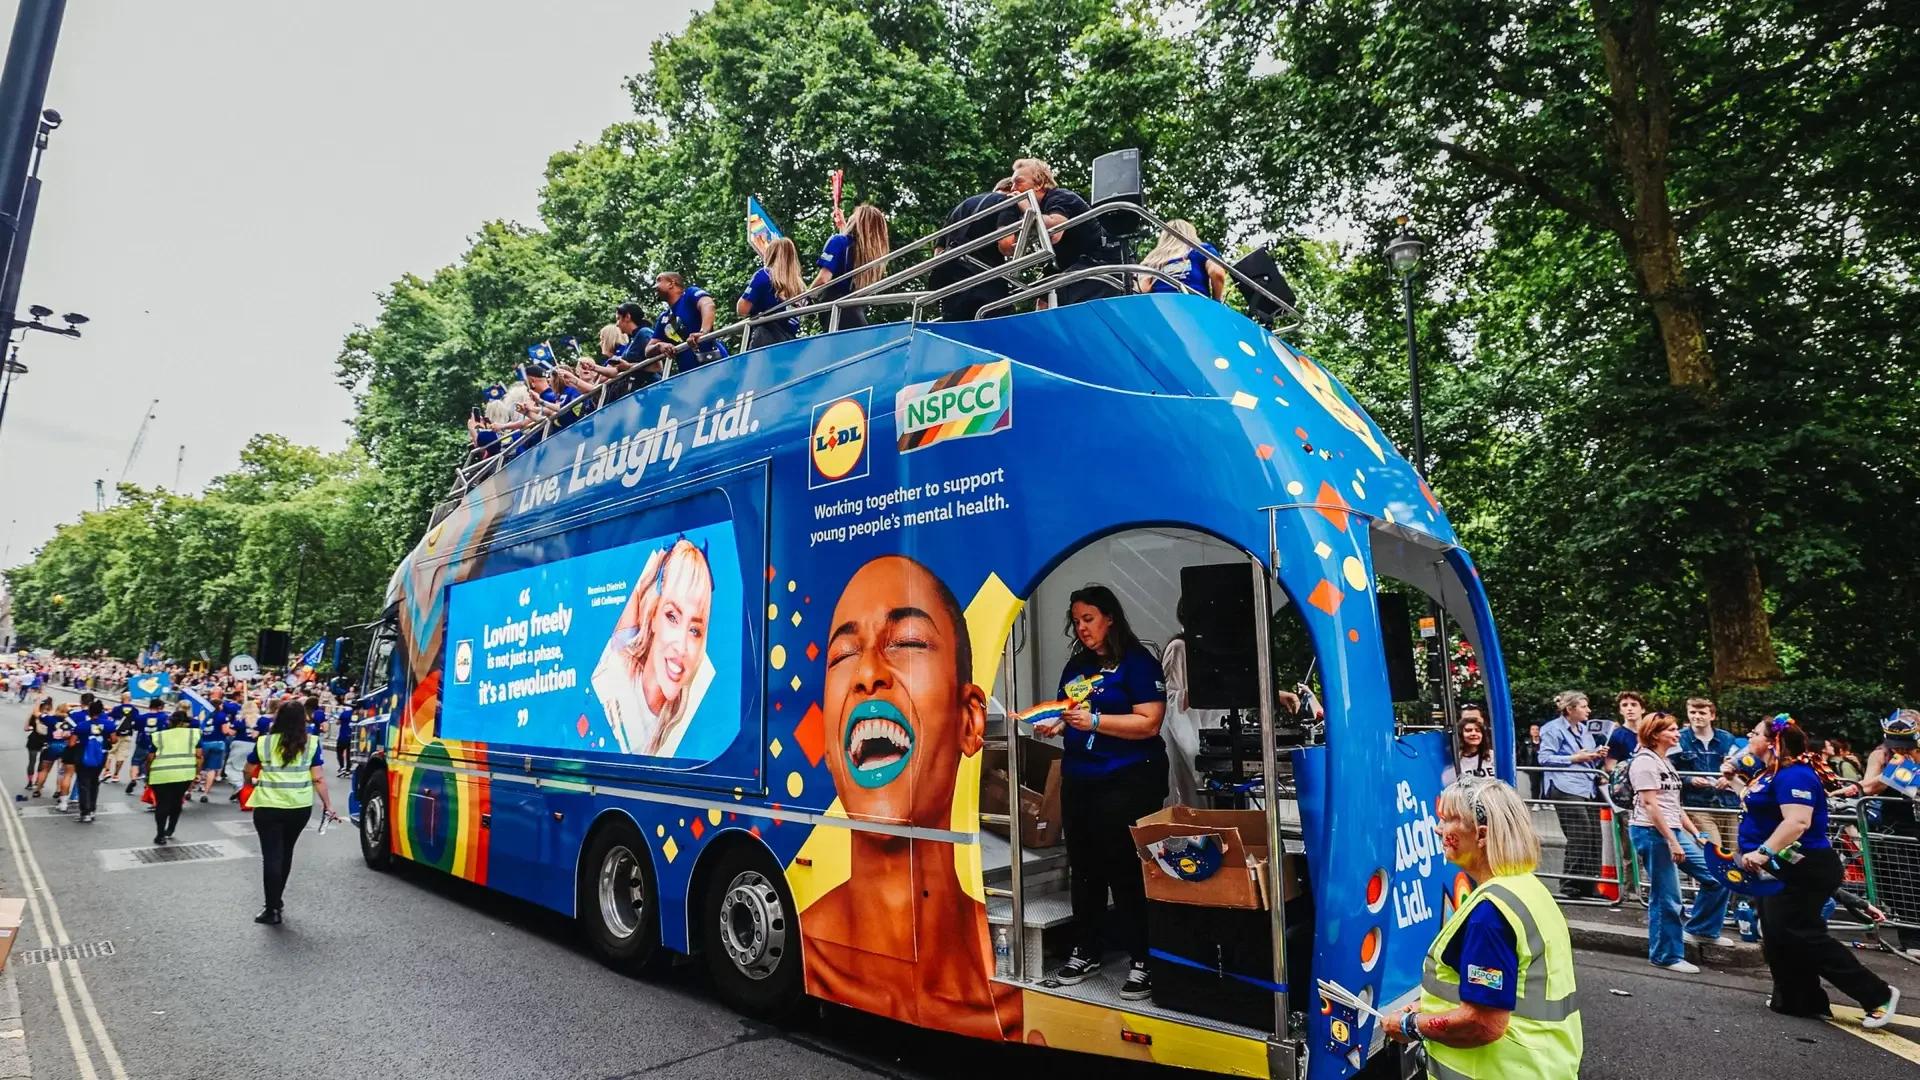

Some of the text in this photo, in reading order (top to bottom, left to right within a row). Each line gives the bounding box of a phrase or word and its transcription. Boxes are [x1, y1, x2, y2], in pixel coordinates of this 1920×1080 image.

[907, 381, 995, 428] NSPCC
[518, 390, 759, 514] Live, Laugh, Lidl.
[814, 467, 1004, 520] Working together to support
[810, 493, 1010, 547] young people’s mental health.
[483, 602, 573, 649] Loving freely
[234, 664, 254, 672] LIDL
[487, 644, 563, 670] is not just a phase,
[498, 683, 506, 702] a
[507, 663, 576, 700] revolution
[1393, 878, 1433, 929] Lidl.
[1471, 970, 1498, 982] NSPCC
